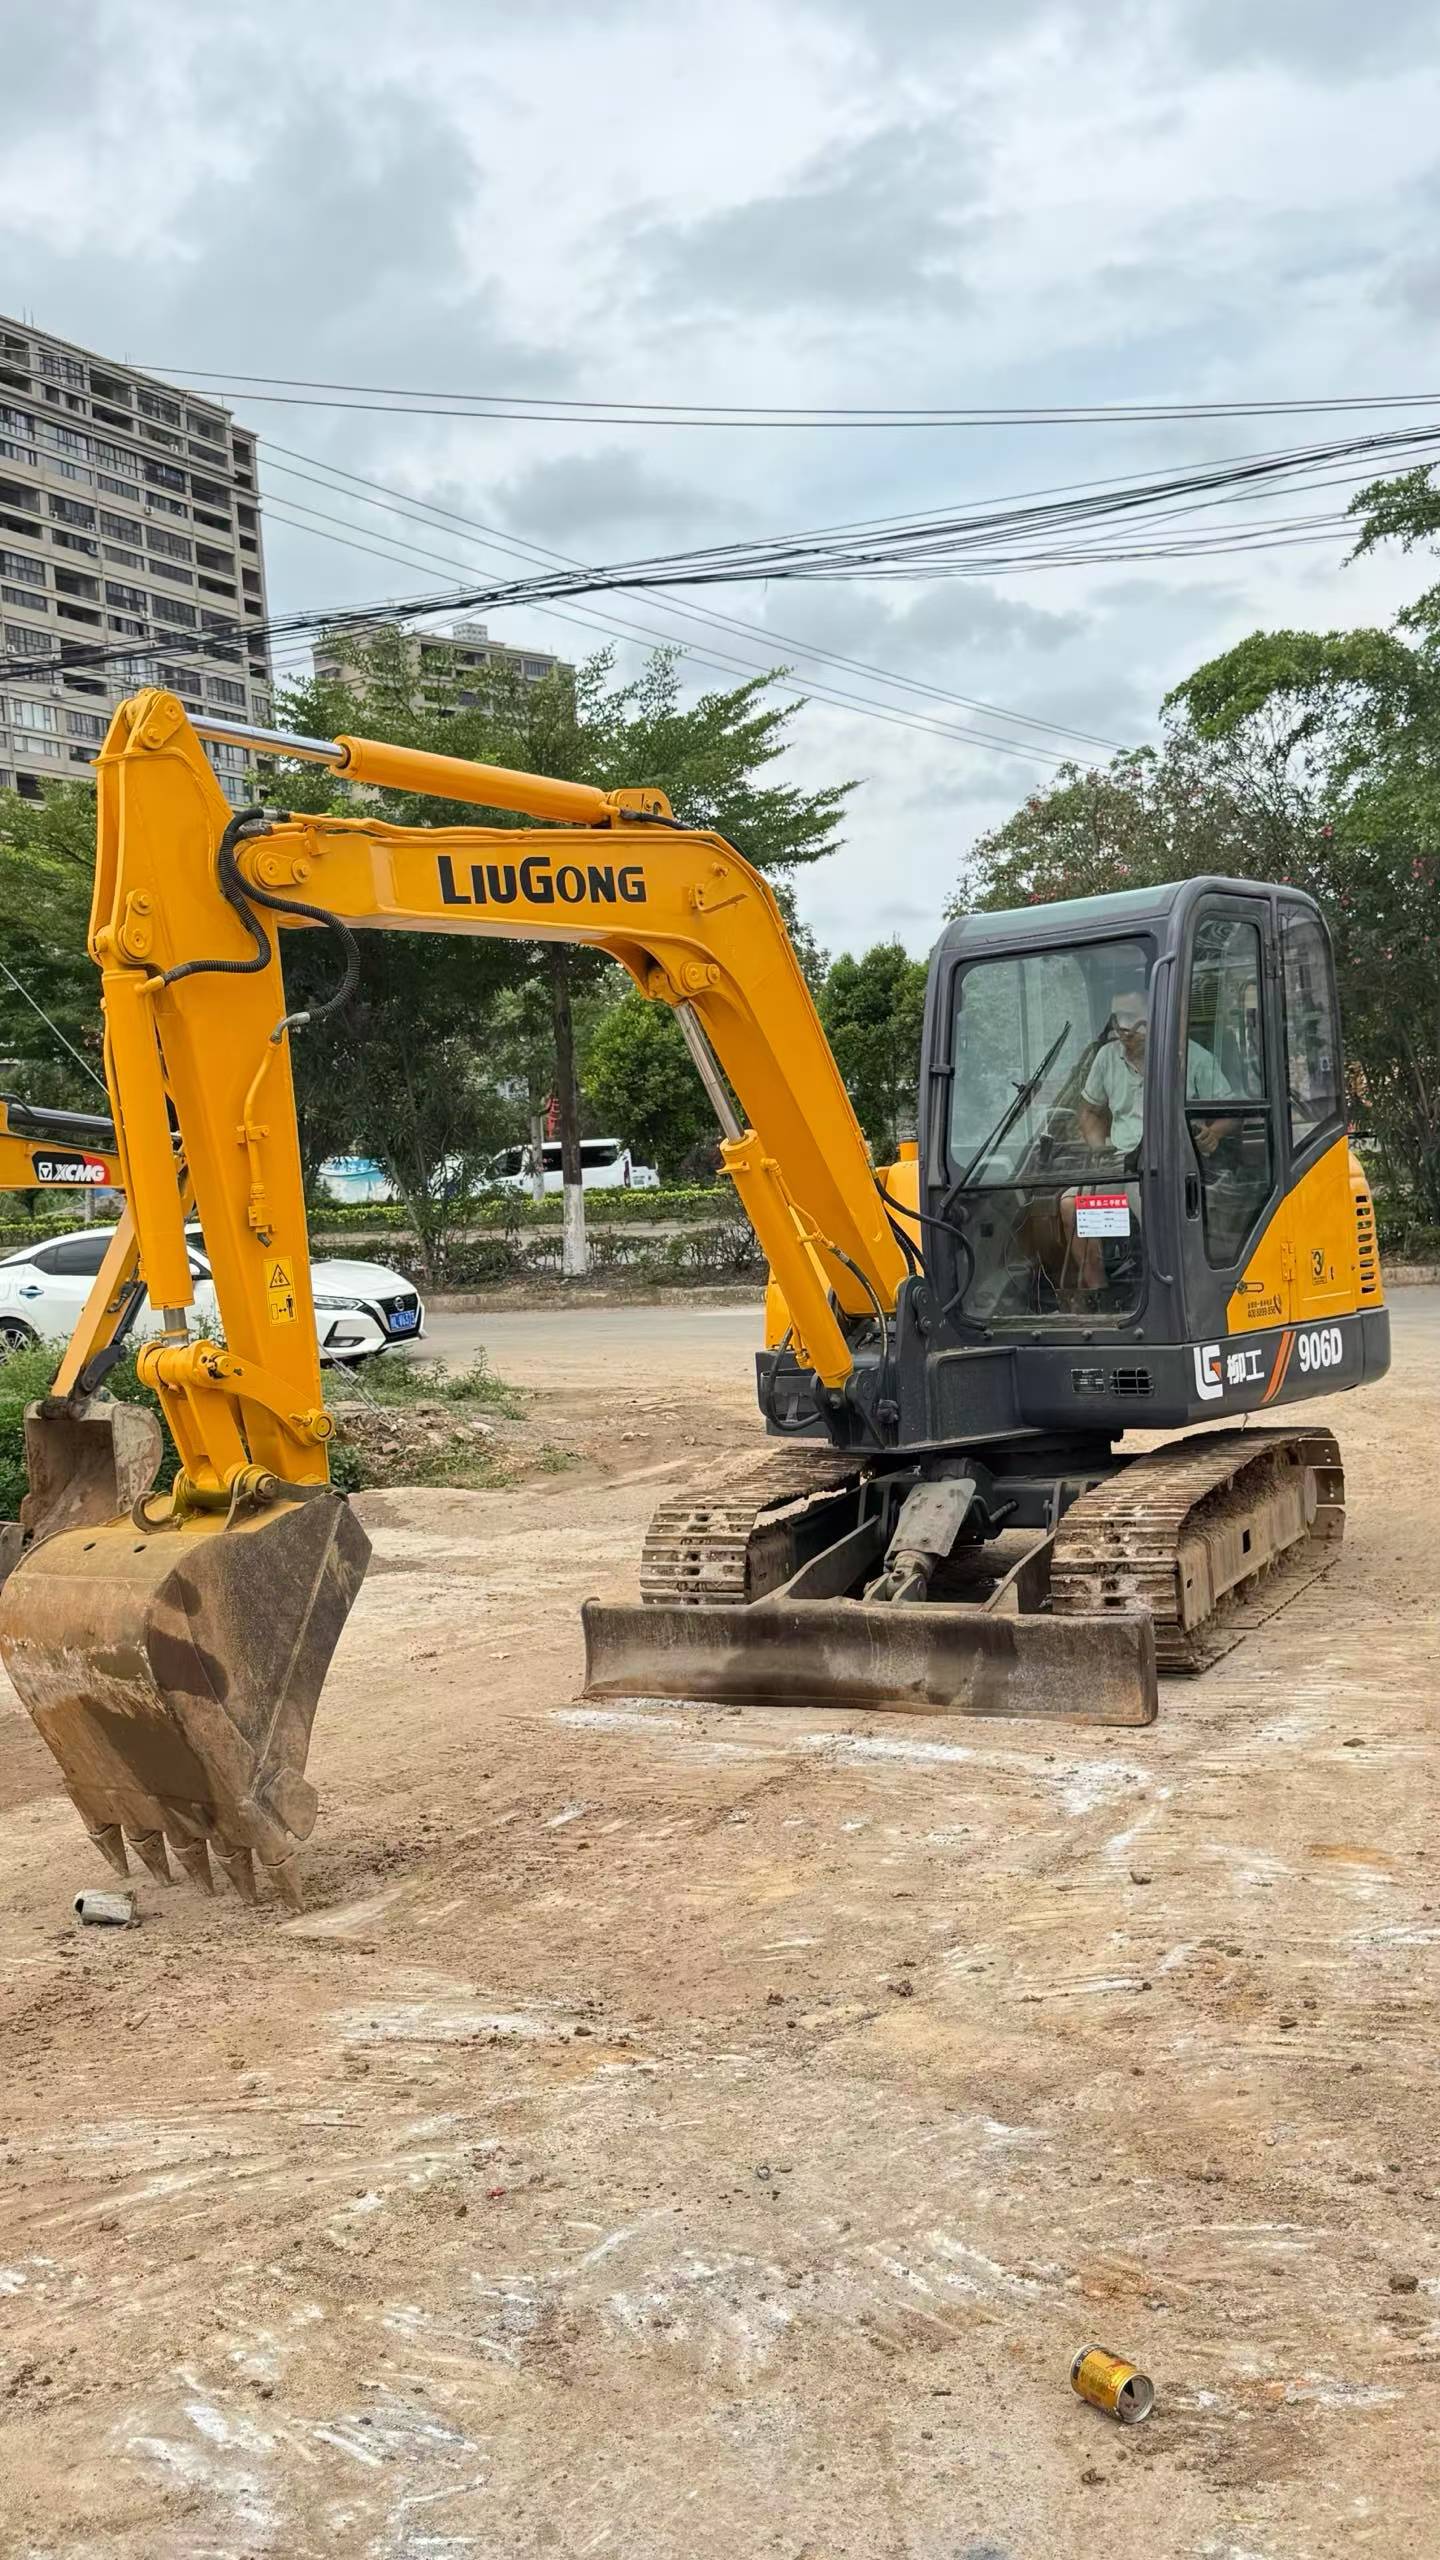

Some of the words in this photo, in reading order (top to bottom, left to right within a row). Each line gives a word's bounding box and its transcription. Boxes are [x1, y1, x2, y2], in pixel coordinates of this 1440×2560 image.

[54, 1165, 104, 1181] XCMG
[1227, 1350, 1264, 1384] 柳工
[1298, 1328, 1343, 1373] 906D
